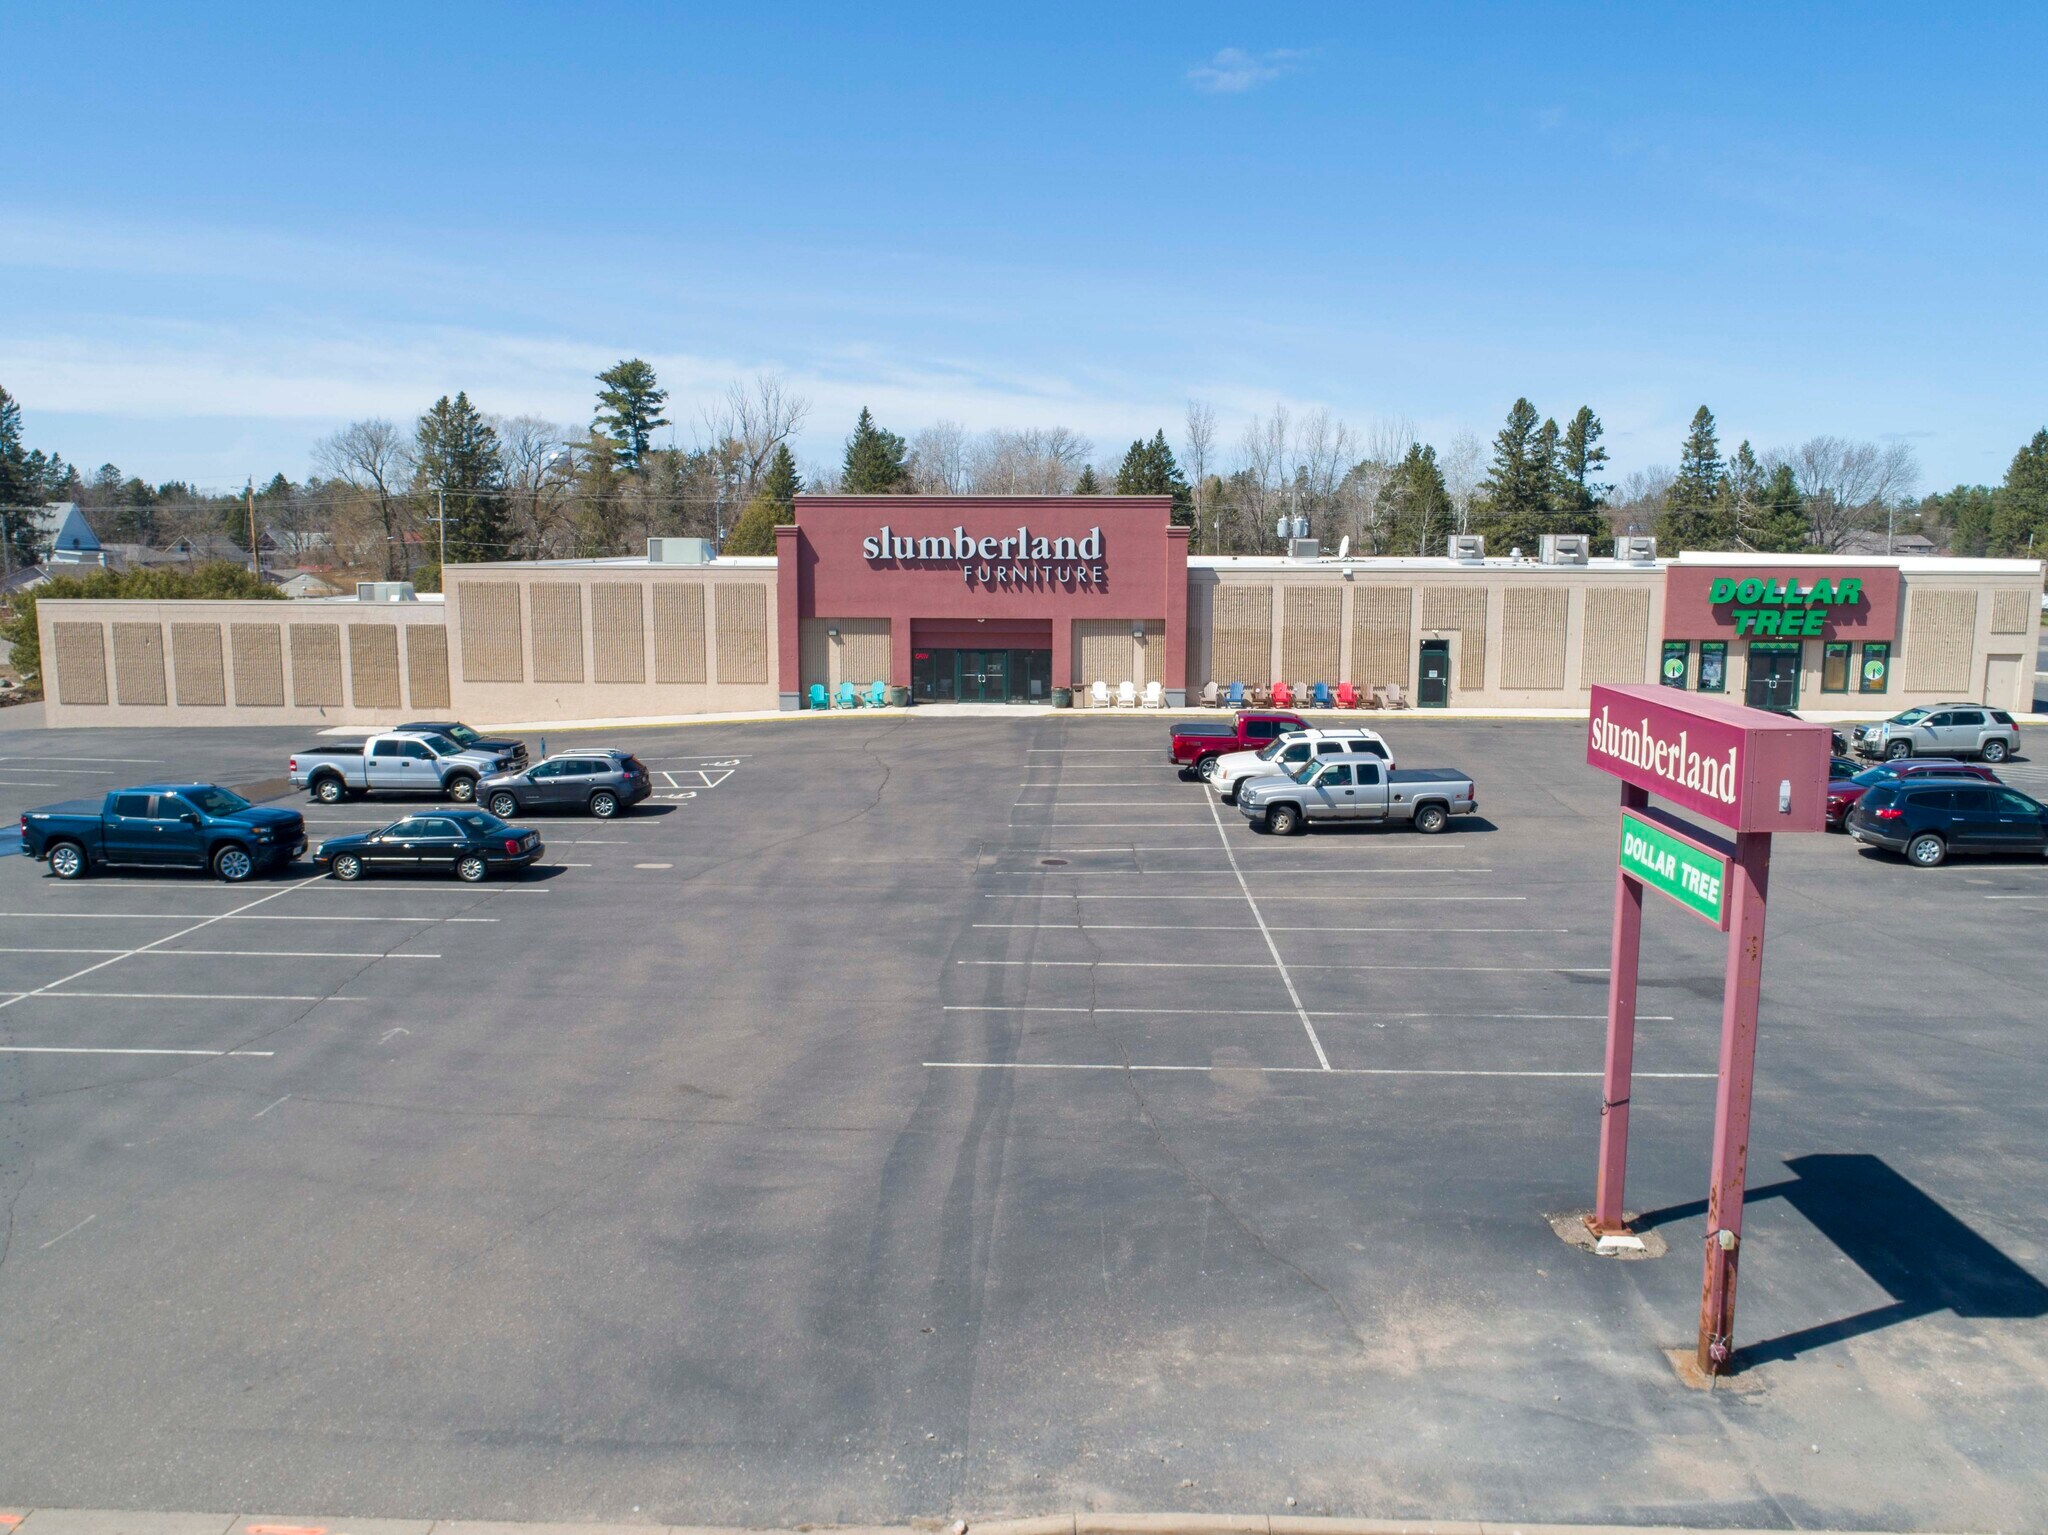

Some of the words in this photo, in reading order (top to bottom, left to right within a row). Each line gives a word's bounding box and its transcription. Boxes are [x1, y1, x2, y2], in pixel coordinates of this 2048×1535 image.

[862, 525, 1102, 560] slumberland
[963, 565, 1103, 583] FURNITURE
[1708, 577, 1863, 605] DOLLAR
[1731, 609, 1828, 636] TREE
[1591, 705, 1737, 804] slumberland
[1624, 832, 1676, 881] DOLLAR
[1681, 862, 1720, 905] TREE
